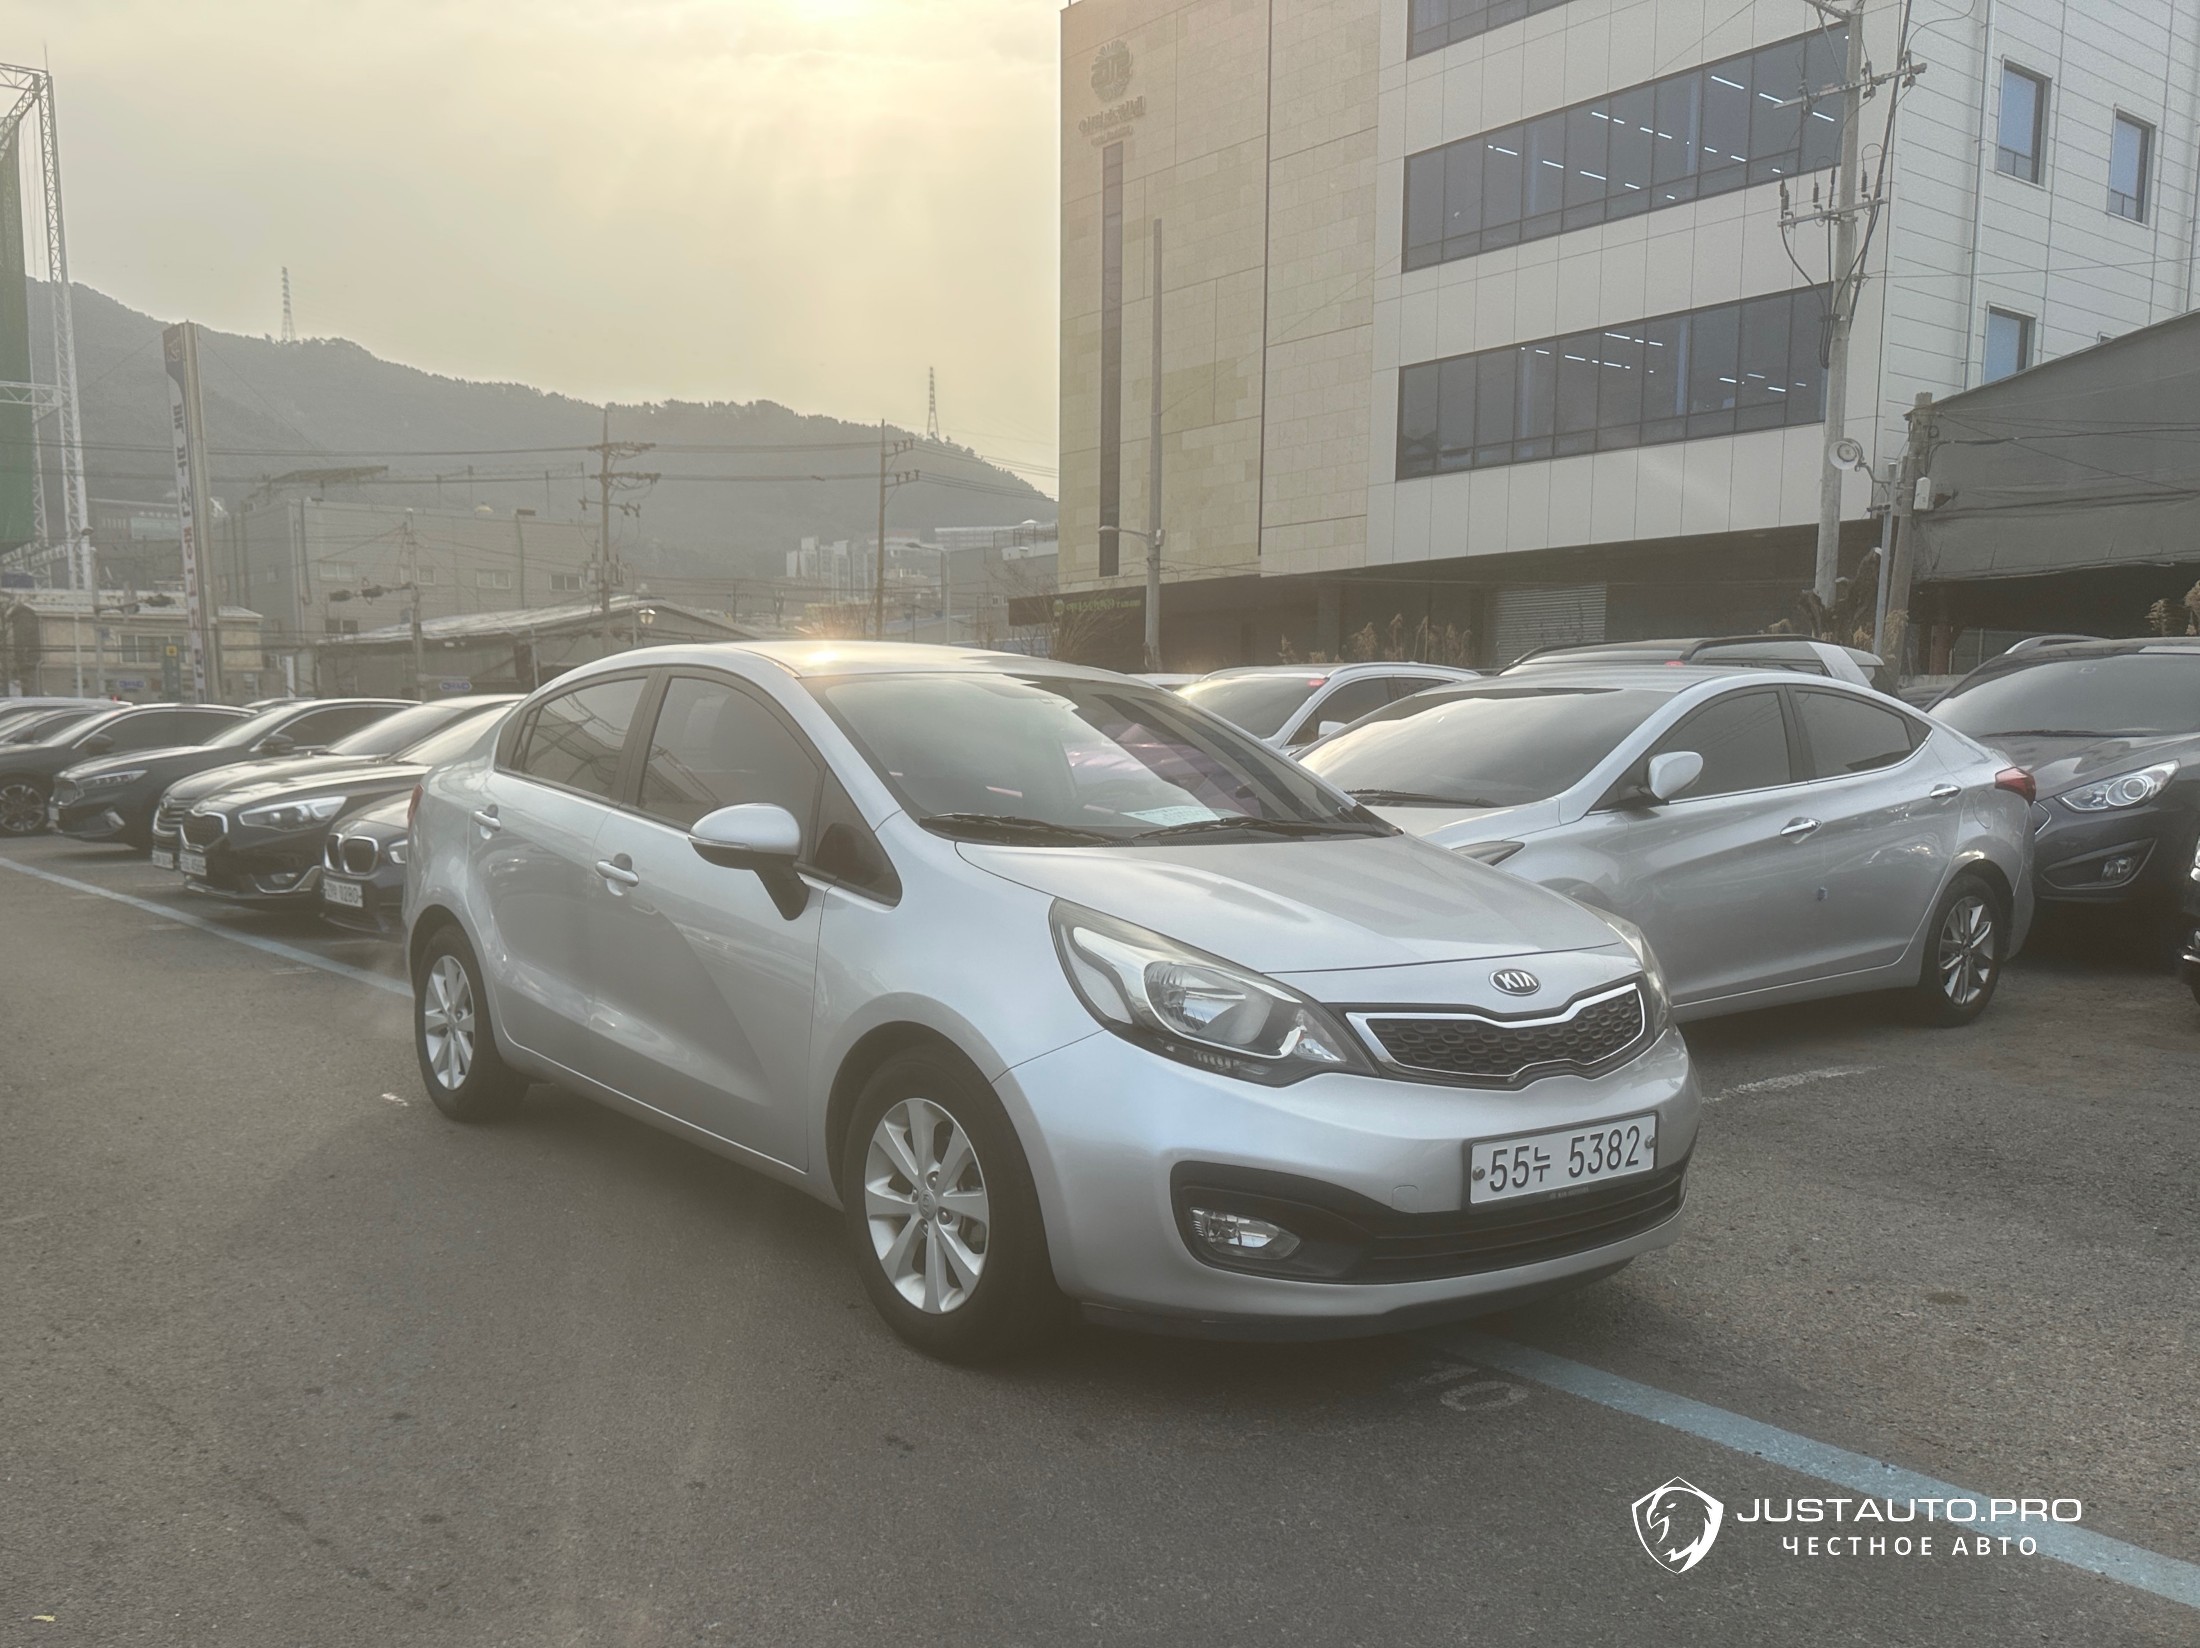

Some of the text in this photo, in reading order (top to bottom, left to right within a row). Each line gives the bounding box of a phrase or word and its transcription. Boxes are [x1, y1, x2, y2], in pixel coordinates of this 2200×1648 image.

[1496, 972, 1537, 990] KIA
[1489, 1125, 1640, 1192] 55누 5382
